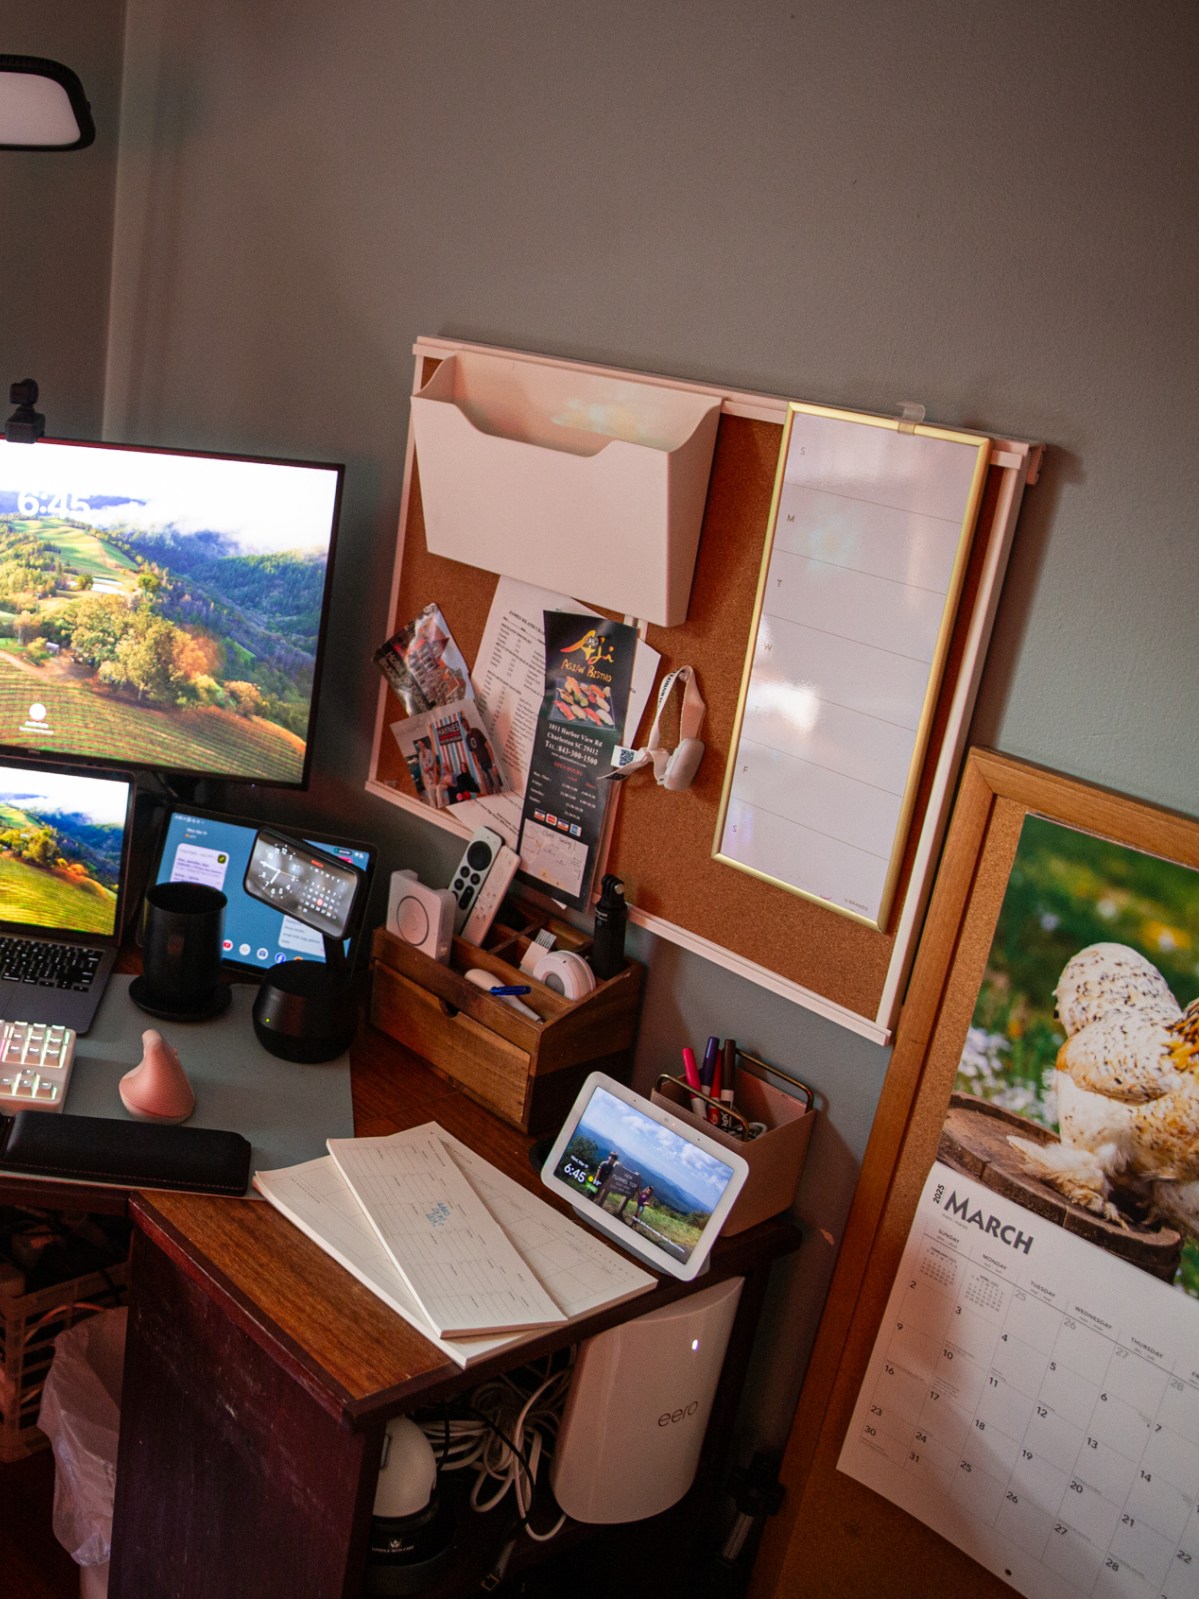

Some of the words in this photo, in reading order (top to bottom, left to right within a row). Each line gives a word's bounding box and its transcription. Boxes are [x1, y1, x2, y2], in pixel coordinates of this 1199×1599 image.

[800, 447, 806, 456] S
[18, 489, 91, 518] 6:45
[787, 514, 795, 523] M
[776, 579, 782, 588] T
[764, 642, 773, 652] W
[743, 766, 748, 774] F
[732, 824, 738, 833] S
[564, 1163, 586, 1183] 6:45
[933, 1184, 944, 1204] 2025
[944, 1190, 1034, 1255] MARCH
[938, 1228, 960, 1244] SUNDAY
[982, 1254, 1007, 1270] MONDAY
[910, 1280, 917, 1290] 2
[1031, 1281, 1056, 1298] TUESDAY
[1014, 1290, 1026, 1301] 25
[955, 1306, 962, 1315] 3
[1074, 1306, 1112, 1329] WEDNESDAY
[896, 1322, 903, 1330] 9
[1064, 1317, 1076, 1330] 26
[1001, 1334, 1008, 1342] 4
[1115, 1347, 1128, 1358] 27
[1131, 1337, 1163, 1358] THURSDAY
[943, 1349, 953, 1360] 10
[885, 1364, 895, 1375] 16
[1050, 1362, 1057, 1371] 5
[989, 1377, 998, 1387] 11
[1170, 1379, 1184, 1391] 28
[930, 1391, 940, 1400] 17
[1100, 1393, 1108, 1402] 6
[658, 1400, 699, 1428] eero
[870, 1405, 882, 1416] 23
[1037, 1407, 1047, 1418] 12
[864, 1425, 876, 1436] 30
[975, 1420, 985, 1430] 18
[1155, 1424, 1162, 1432] 7
[915, 1432, 927, 1442] 24
[1088, 1437, 1098, 1449] 13
[910, 1452, 919, 1462] 31
[1022, 1449, 1033, 1460] 19
[960, 1461, 972, 1472] 25
[1140, 1470, 1151, 1482] 14
[1070, 1480, 1083, 1493] 20
[1006, 1491, 1018, 1504] 26
[1121, 1514, 1134, 1527] 21
[1054, 1523, 1068, 1535] 27
[1176, 1549, 1192, 1564] 22
[1105, 1558, 1119, 1572] 28
